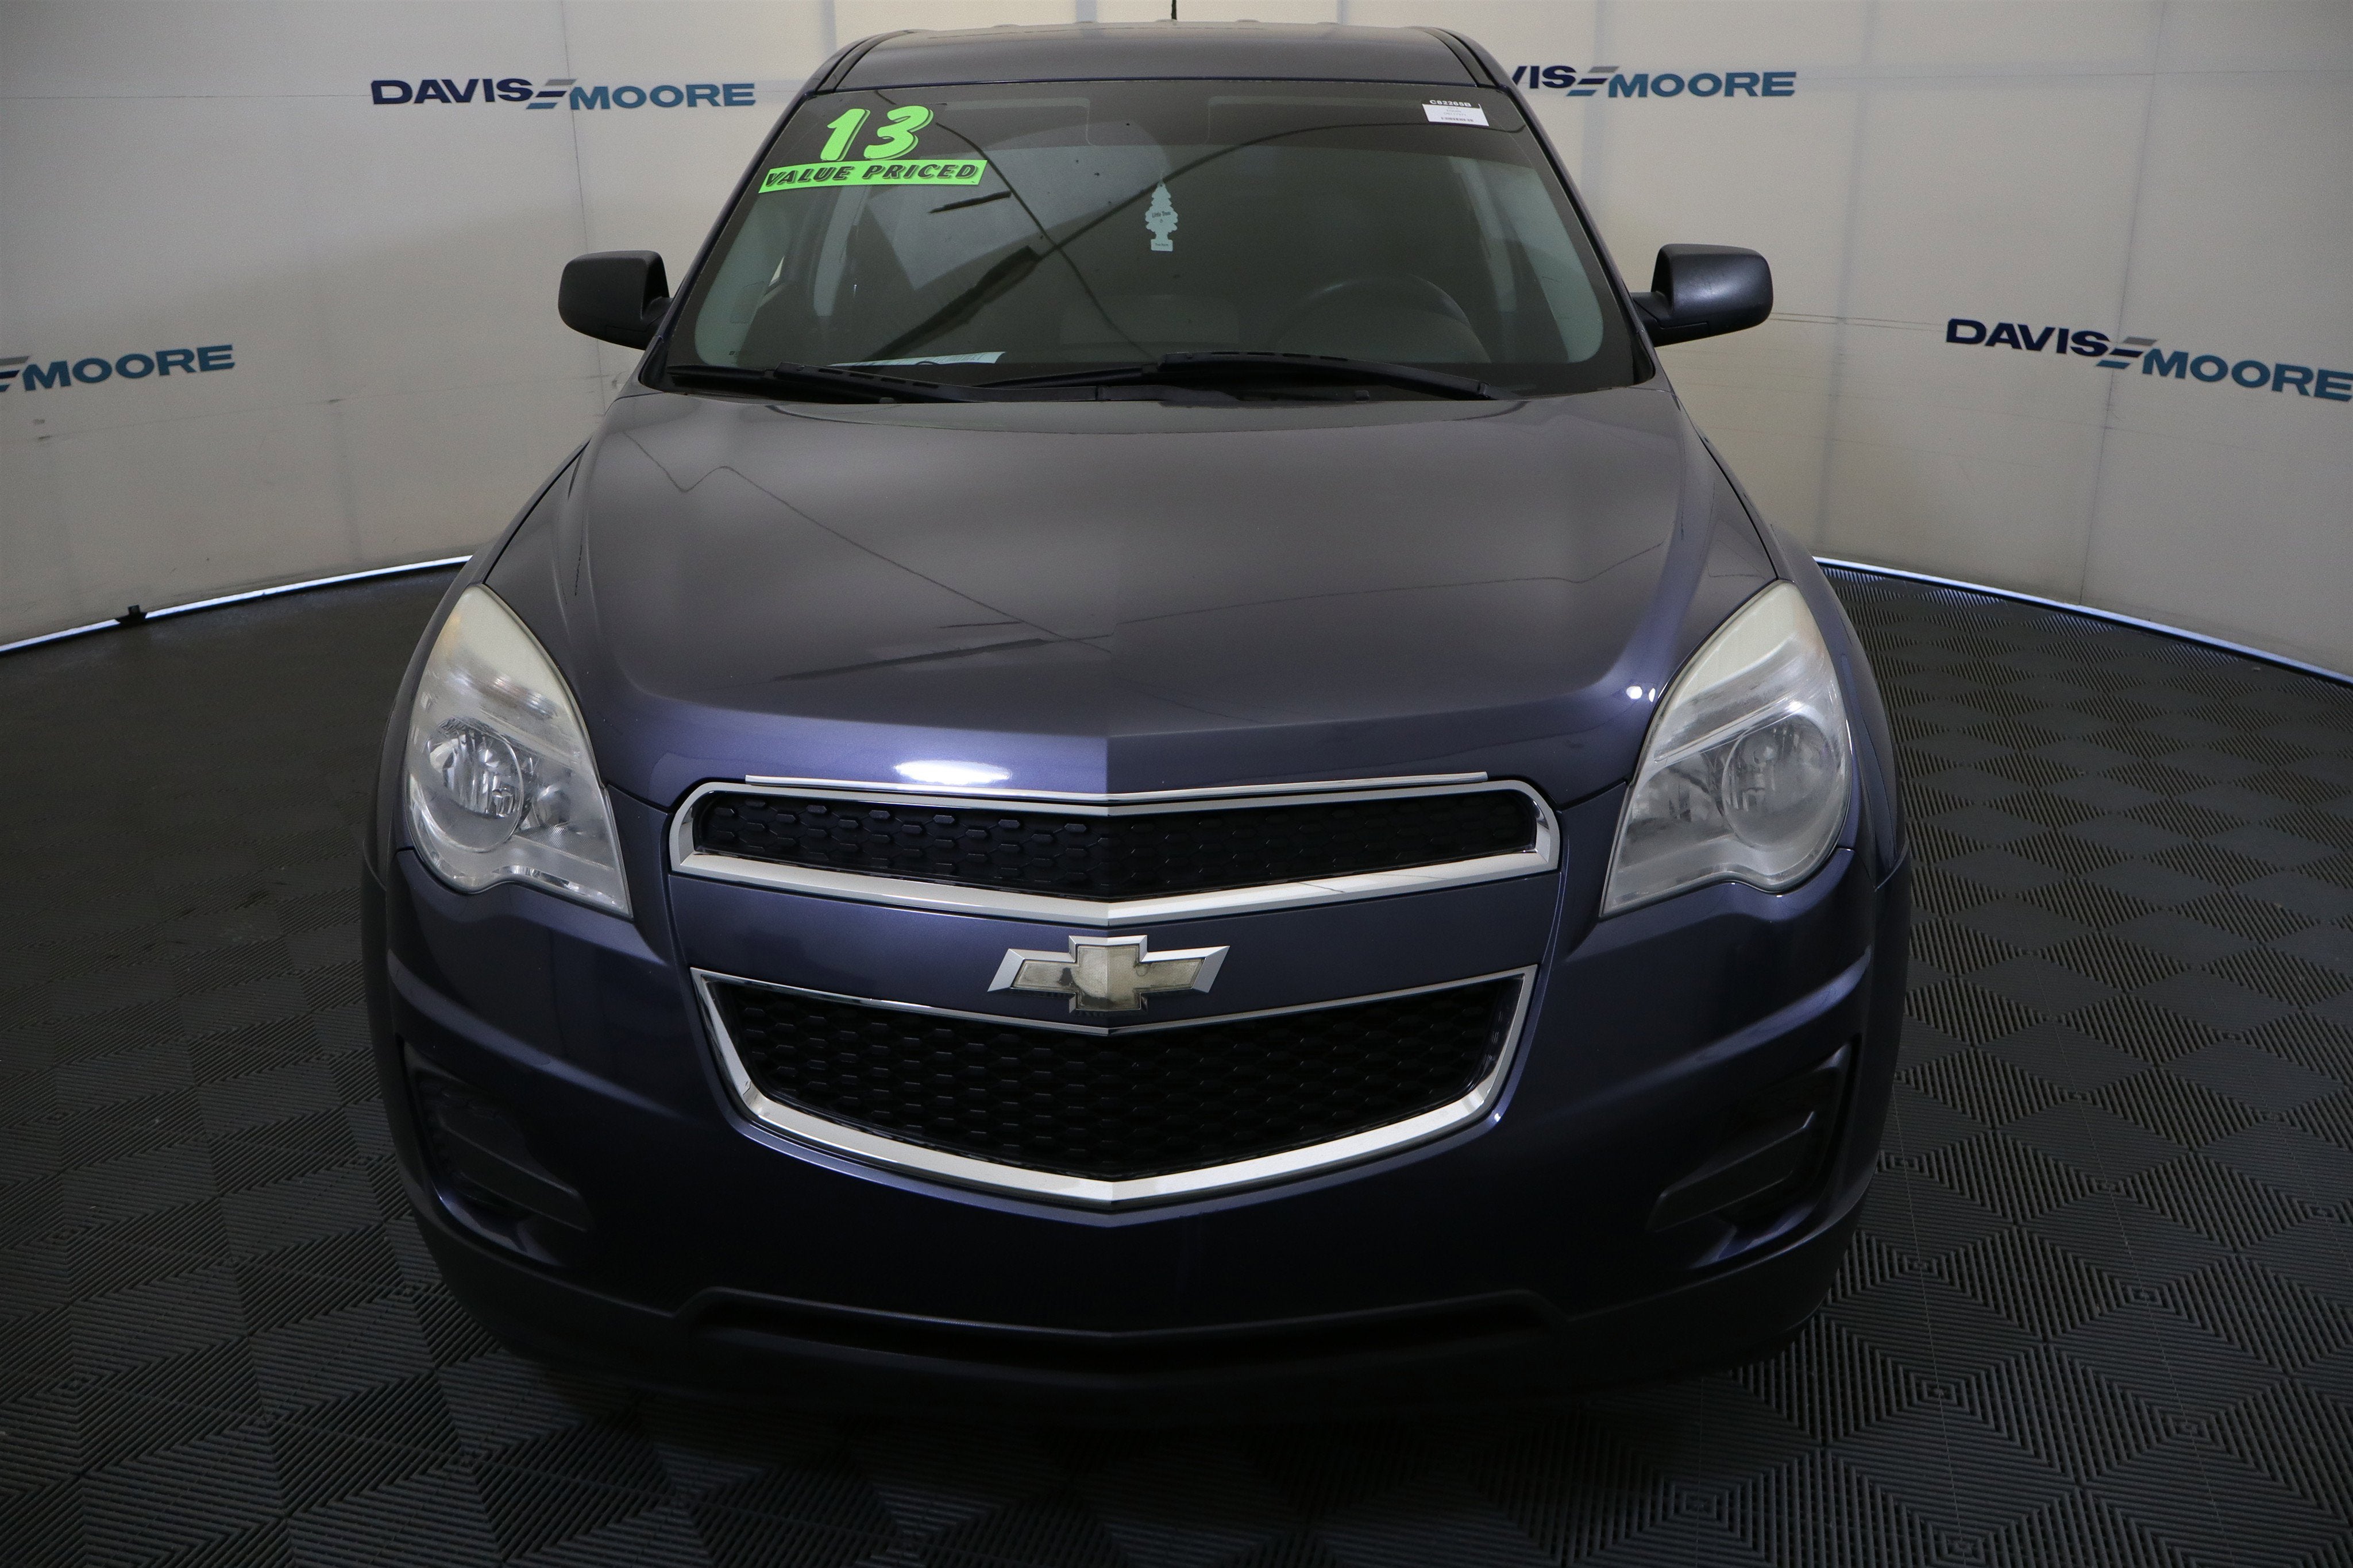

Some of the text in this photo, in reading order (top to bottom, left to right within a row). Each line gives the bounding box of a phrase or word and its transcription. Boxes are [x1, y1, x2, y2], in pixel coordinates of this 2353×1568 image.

[371, 78, 756, 110] DAVIS MOORE
[1608, 71, 1797, 98] MOORE
[820, 105, 934, 161] 13
[765, 164, 979, 187] VALUE PRICED
[22, 344, 236, 392] MOORE
[1946, 318, 2353, 402] DAVIS MOORE
